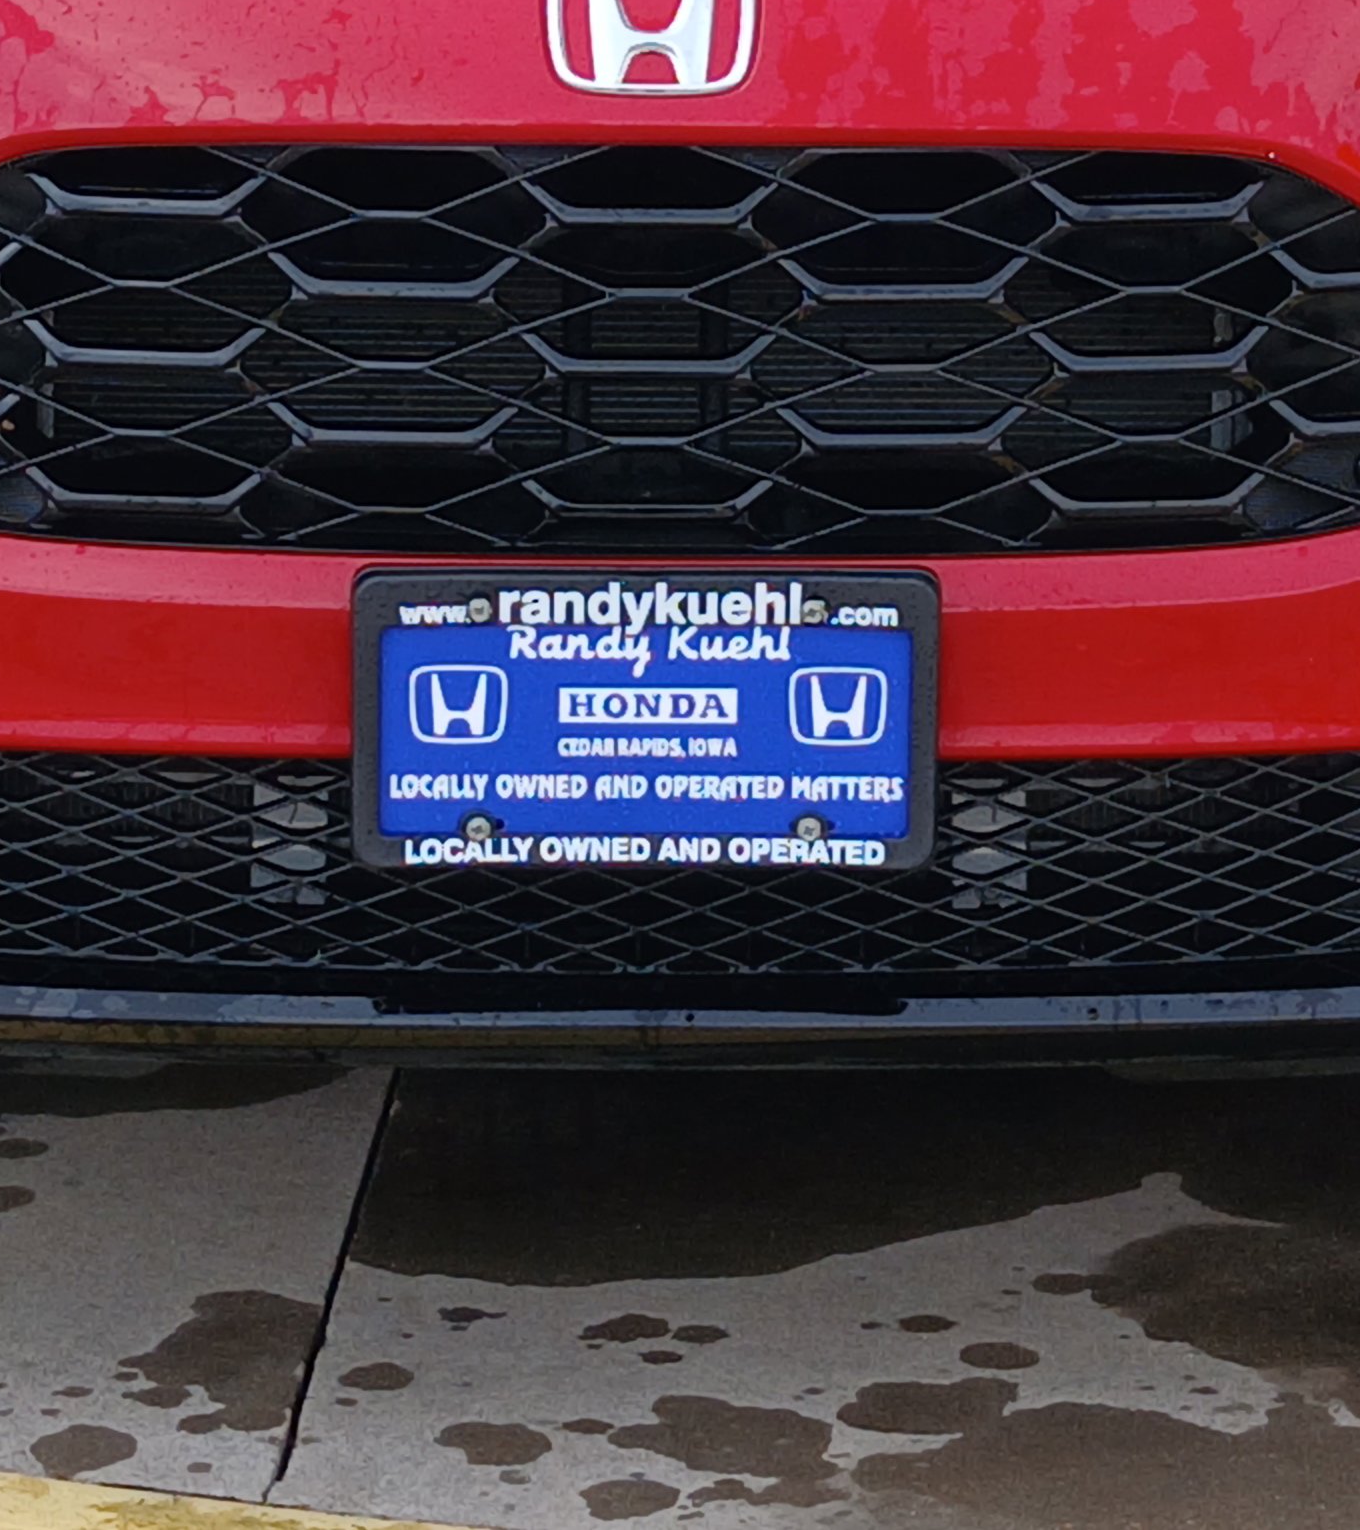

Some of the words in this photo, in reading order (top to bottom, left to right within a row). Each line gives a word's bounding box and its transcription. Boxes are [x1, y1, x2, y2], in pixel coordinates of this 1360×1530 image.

[507, 624, 651, 678] Randy
[667, 626, 792, 661] Kuehl
[568, 692, 729, 719] HONDA
[688, 736, 738, 758] IOWA
[389, 774, 489, 801] LOCALLY
[495, 774, 589, 800] OWNED
[594, 774, 649, 801] AND
[654, 775, 785, 802] OPERATED
[791, 776, 905, 803] MATTERS
[404, 837, 534, 865] LOCALLY
[539, 836, 651, 863] OWNED
[657, 837, 722, 863] AND
[727, 838, 886, 866] OPERATED
